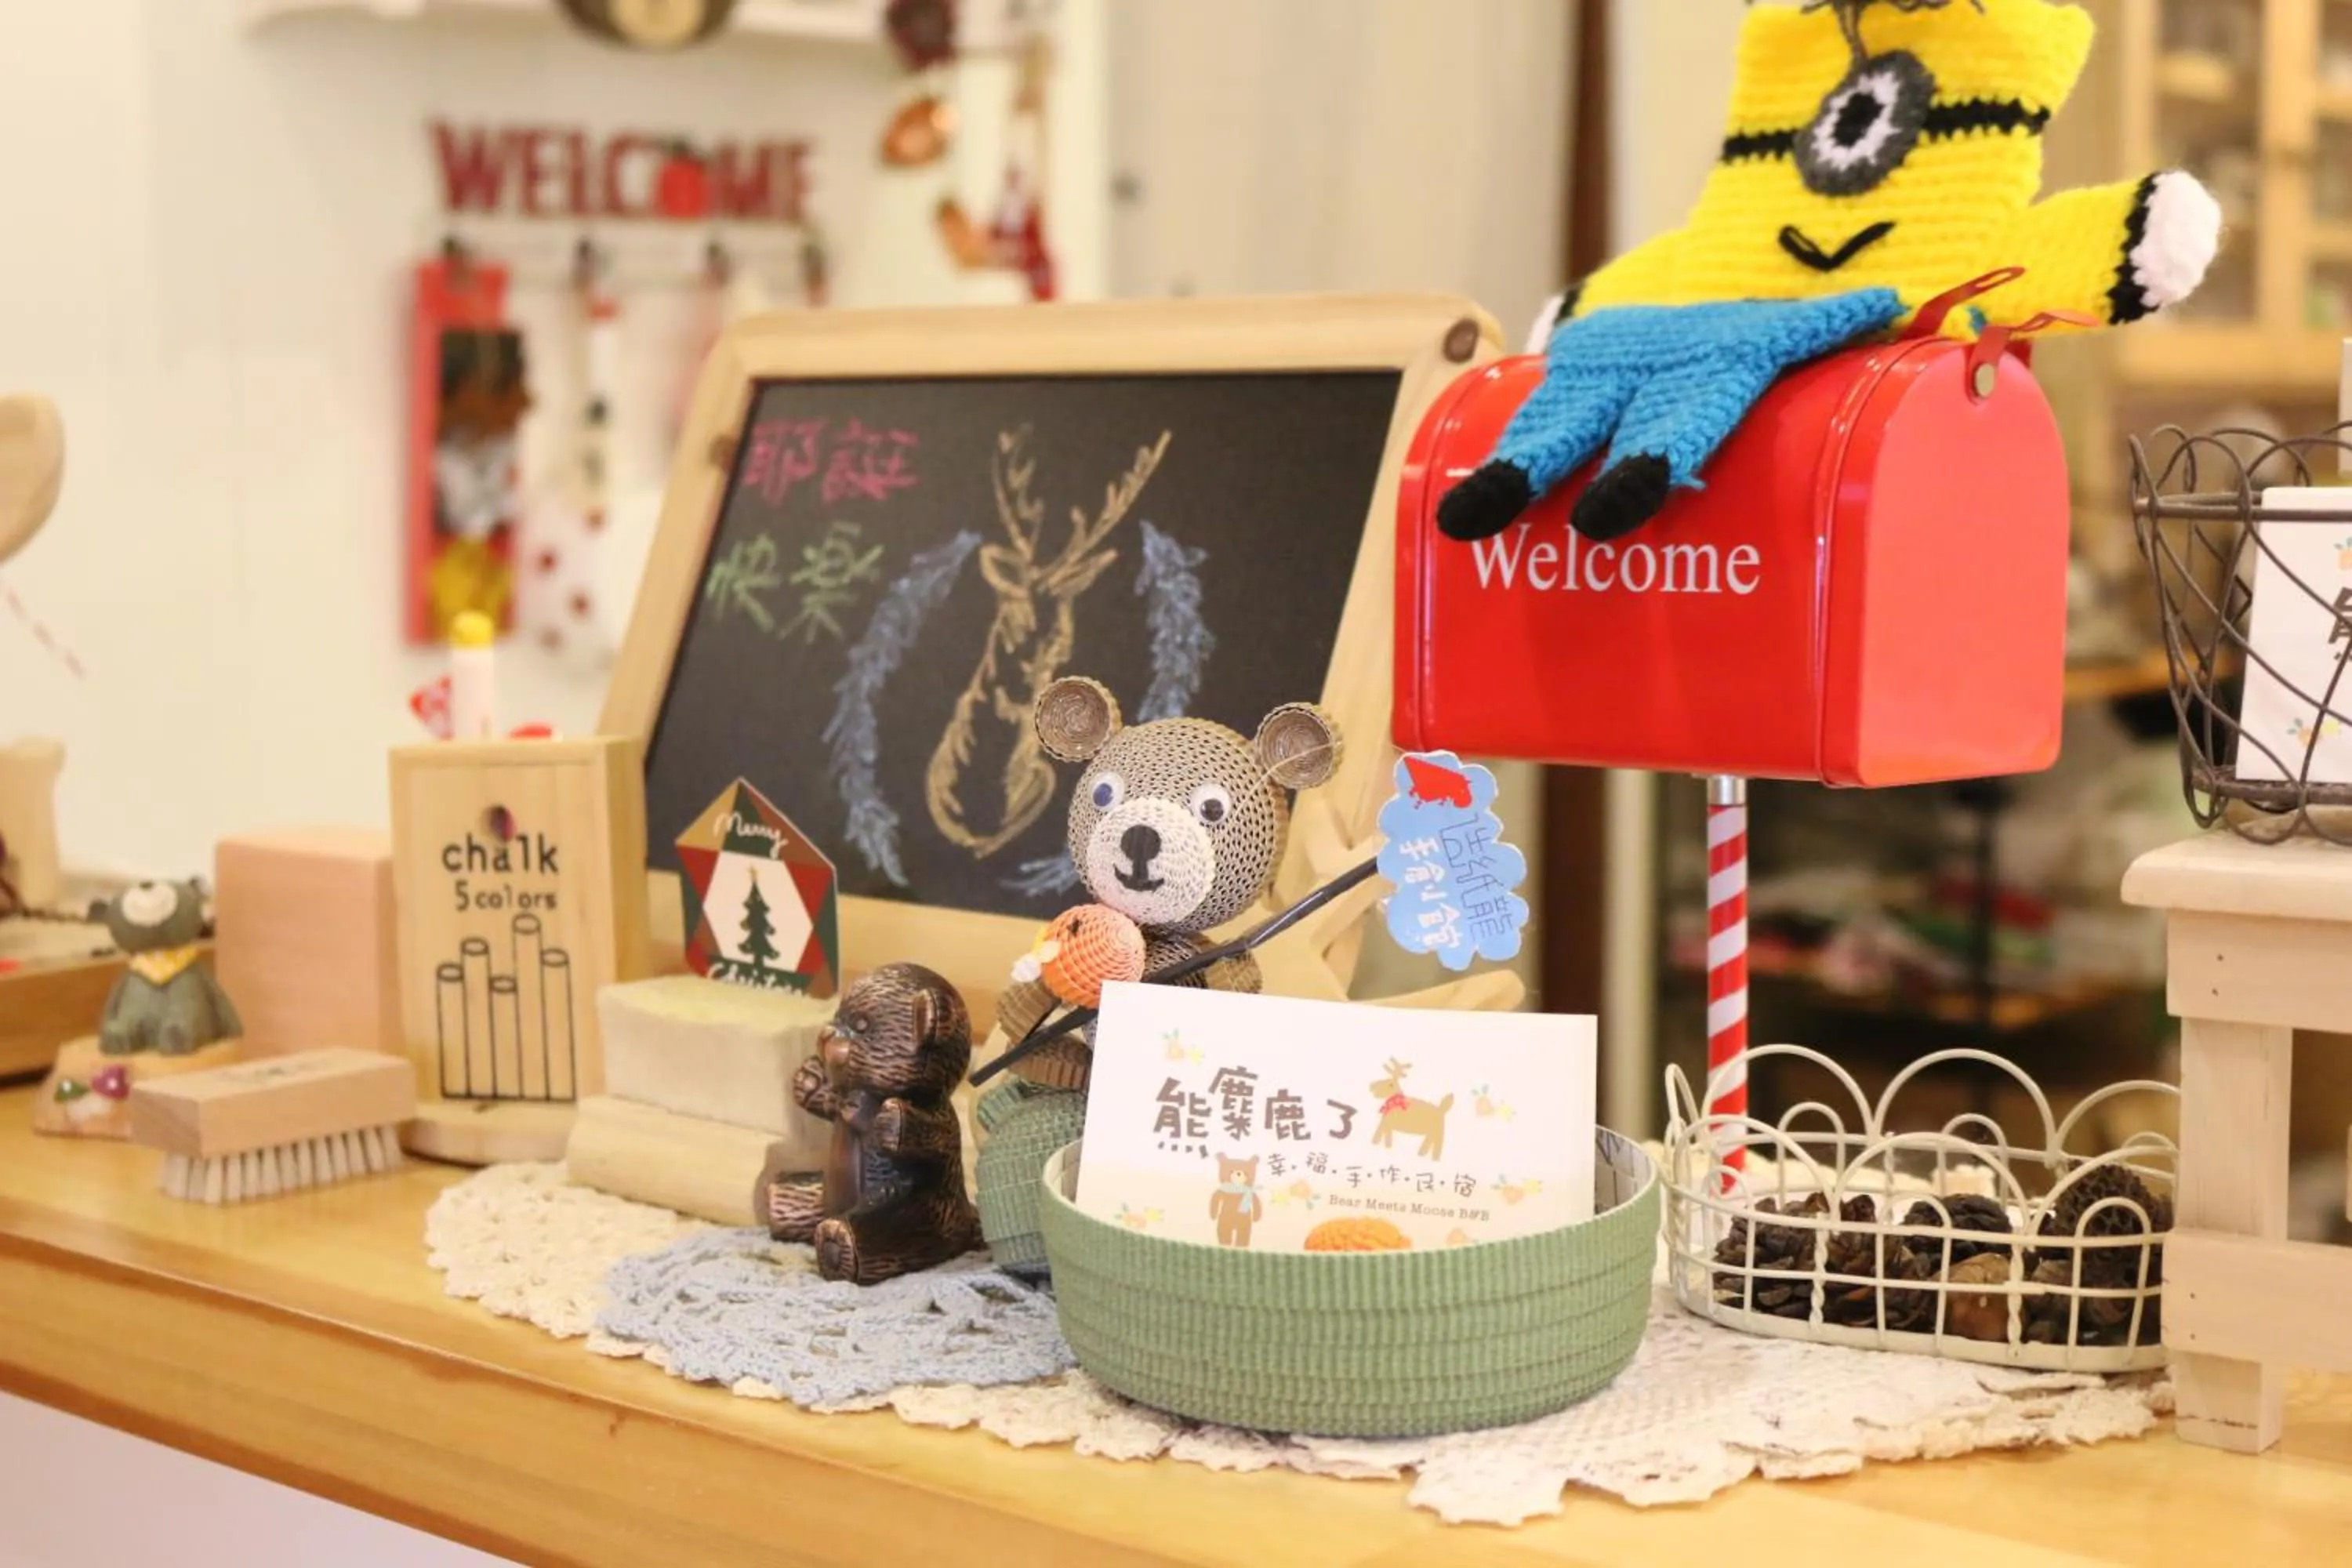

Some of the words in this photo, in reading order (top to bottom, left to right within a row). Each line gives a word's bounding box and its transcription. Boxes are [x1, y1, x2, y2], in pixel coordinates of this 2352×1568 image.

[706, 521, 884, 644] 快樂
[1471, 523, 1762, 595] Welcome
[442, 832, 559, 874] chalk
[713, 811, 789, 860] Merry
[1400, 837, 1464, 948] 手創館
[1439, 813, 1512, 943] 造紙龍
[1153, 1065, 1358, 1159] 熊麋鹿了
[1330, 1194, 1361, 1208] Bear
[1366, 1198, 1406, 1214] Meets
[1410, 1203, 1455, 1218] Moose
[1459, 1208, 1490, 1221] B&B
